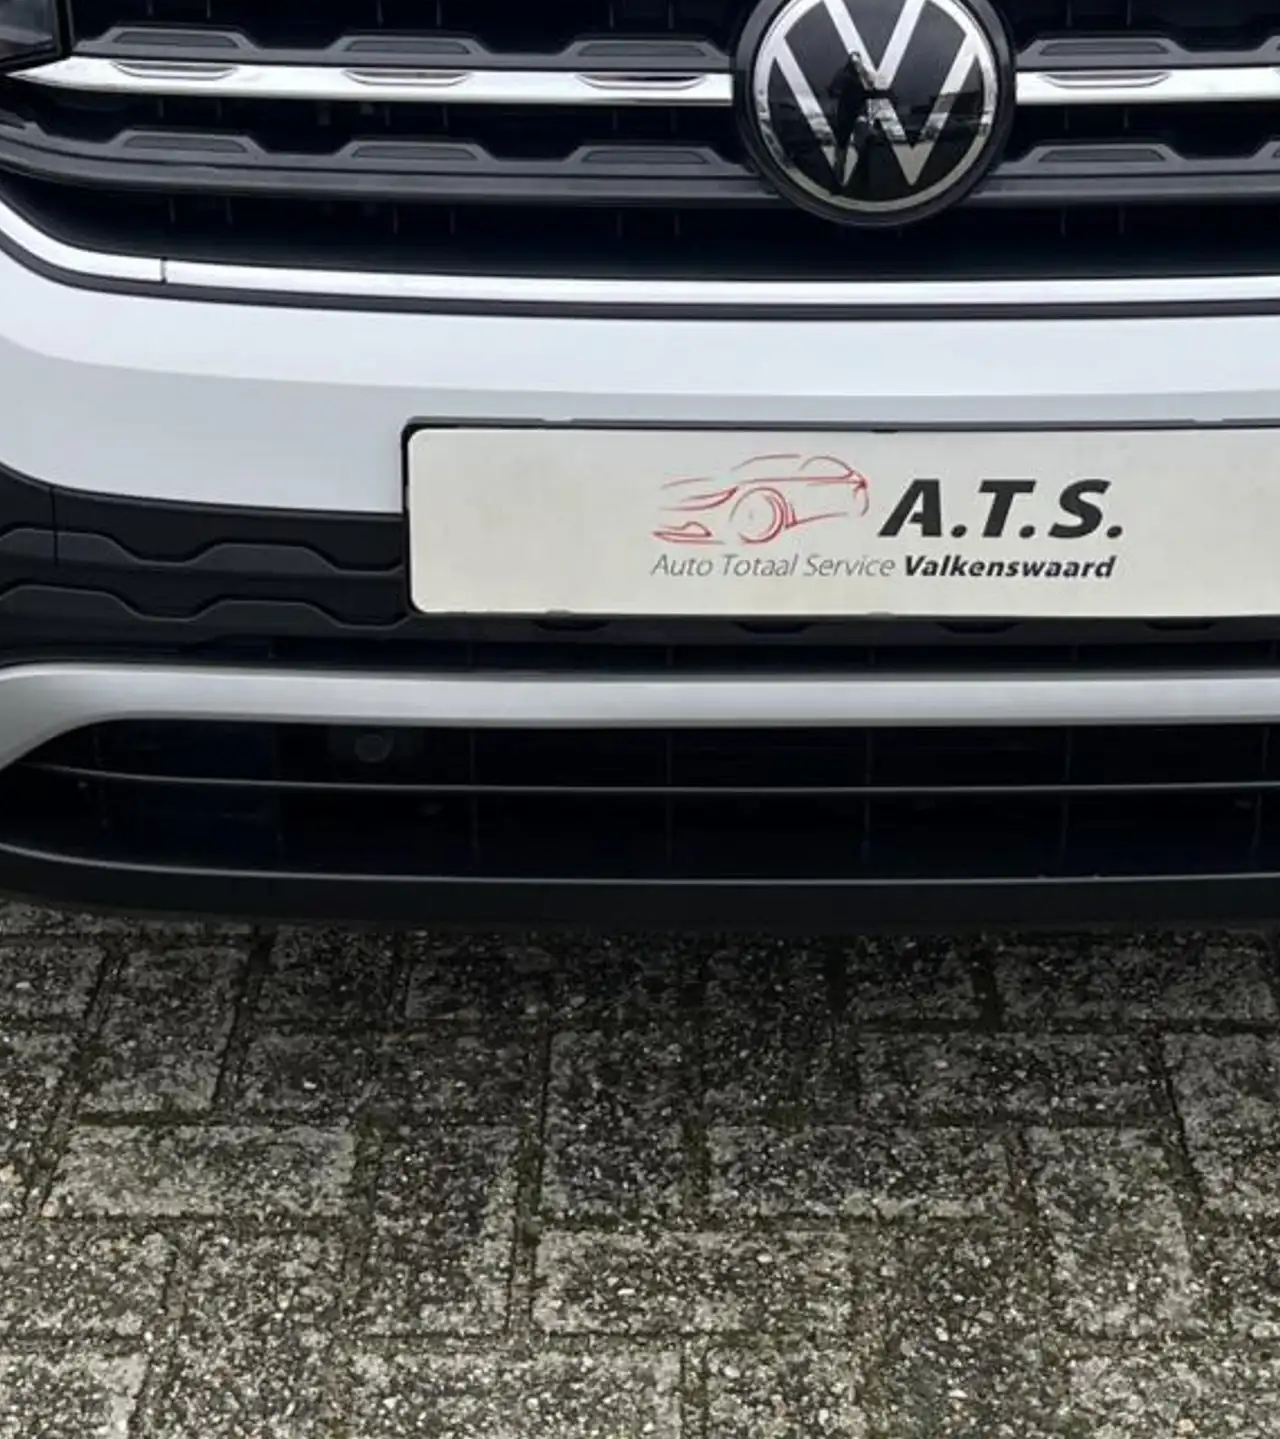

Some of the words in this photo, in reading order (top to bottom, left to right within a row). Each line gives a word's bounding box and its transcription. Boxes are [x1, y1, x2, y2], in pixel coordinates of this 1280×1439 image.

[876, 477, 1124, 540] A.T.S.
[650, 552, 714, 578] Auto
[722, 552, 799, 578] Totaal
[803, 553, 897, 578] Service
[903, 553, 1118, 580] Valkenswaard
